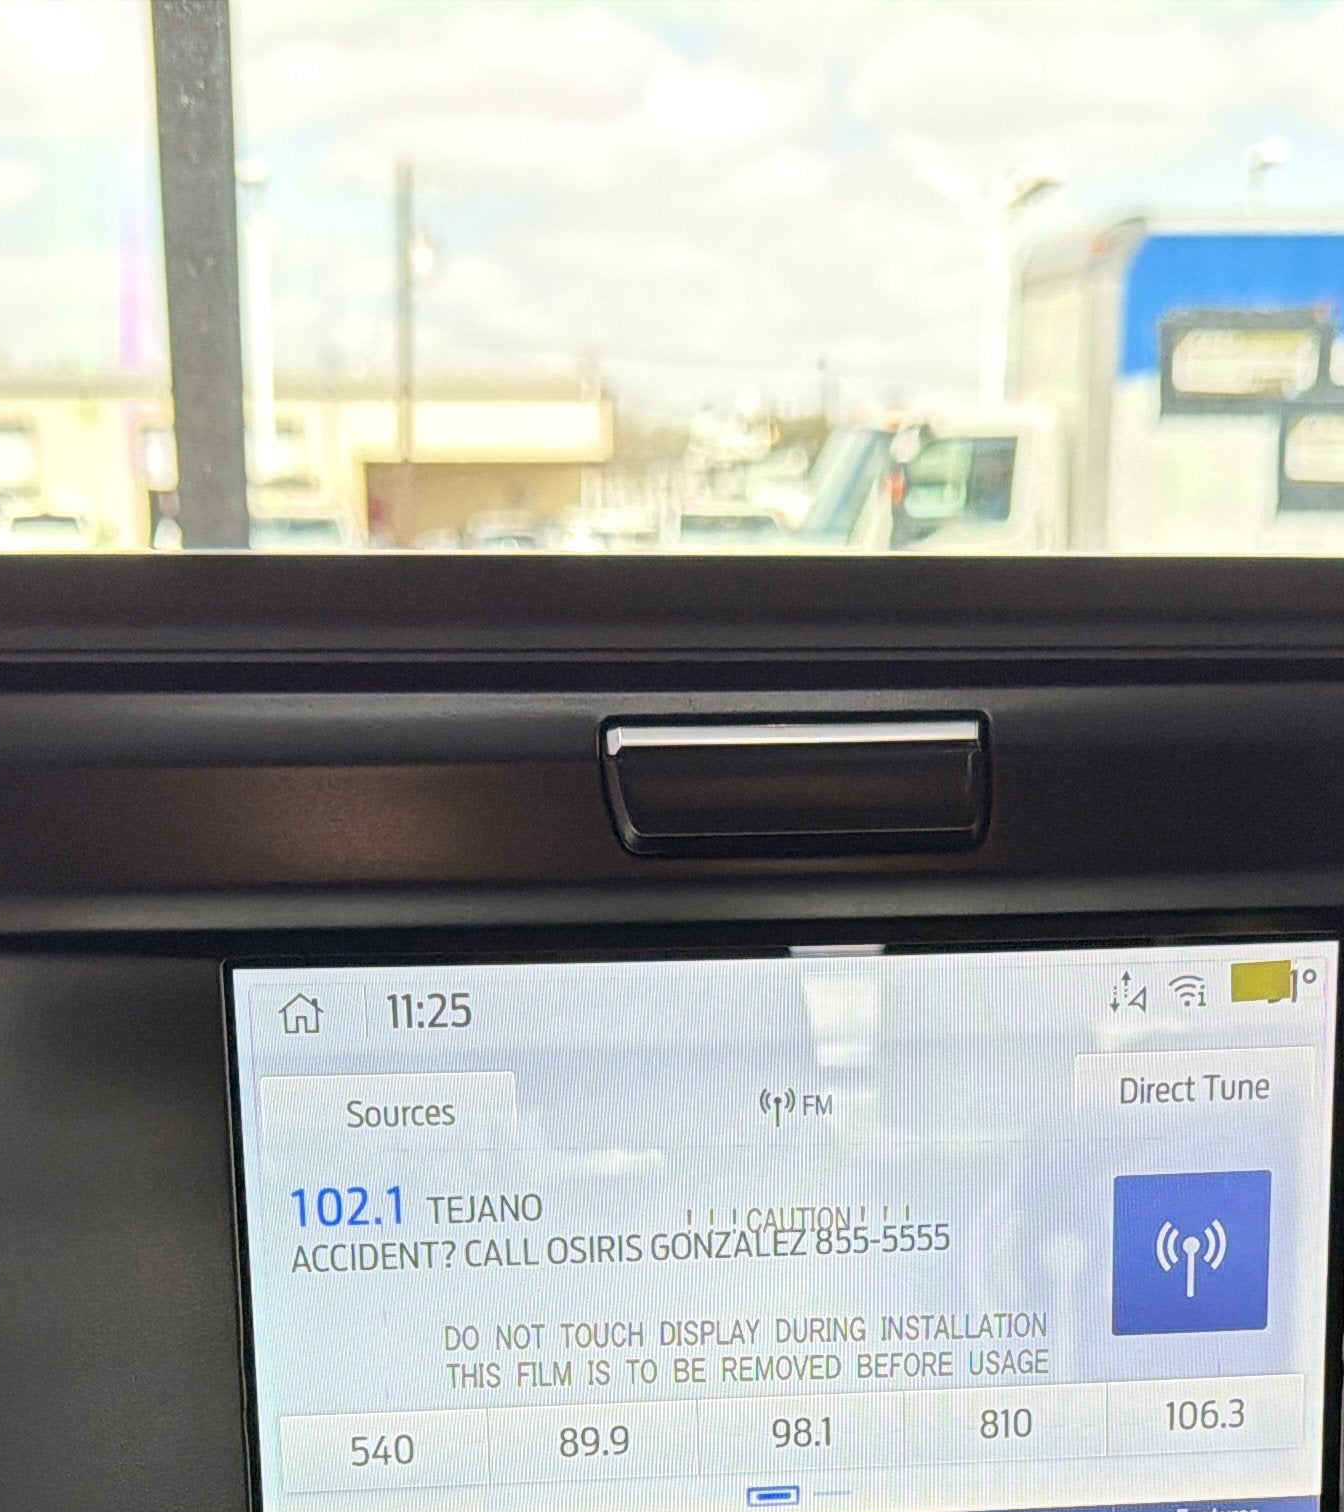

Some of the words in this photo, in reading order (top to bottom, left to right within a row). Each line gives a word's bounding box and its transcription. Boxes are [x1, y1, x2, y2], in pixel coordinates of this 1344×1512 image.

[387, 992, 472, 1029] 11:25
[802, 1095, 833, 1116] FM
[1120, 1075, 1195, 1104] Direct
[1203, 1073, 1270, 1101] Tune
[346, 1100, 456, 1129] Sources
[291, 1186, 404, 1227] 102.1
[426, 1193, 543, 1224] TEJANO
[746, 1206, 851, 1233] CAUTION
[291, 1241, 457, 1274] ACCIDENT?
[464, 1237, 540, 1267] CALL
[546, 1234, 643, 1264] OSIRIS
[650, 1229, 807, 1261] GONZALEZ
[815, 1223, 950, 1255] 855-5555
[444, 1326, 480, 1352] DO
[496, 1324, 545, 1350] NOT
[560, 1321, 644, 1348] TOUCH
[659, 1319, 760, 1346] DISPLAY
[775, 1316, 866, 1343] DURING
[881, 1312, 1048, 1341] INSTALLATION
[446, 1362, 501, 1389] THIS
[517, 1361, 573, 1387] FILM
[587, 1360, 611, 1385] IS
[626, 1359, 658, 1384] TO
[673, 1358, 706, 1383] BE
[721, 1354, 841, 1381] REMOVED
[858, 1352, 955, 1378] BEFORE
[969, 1349, 1050, 1375] USAGE
[351, 1434, 415, 1466] 540
[559, 1425, 631, 1457] 89.9
[772, 1418, 832, 1448] 98.1
[979, 1408, 1033, 1439] 810
[1166, 1398, 1246, 1431] 106.3
